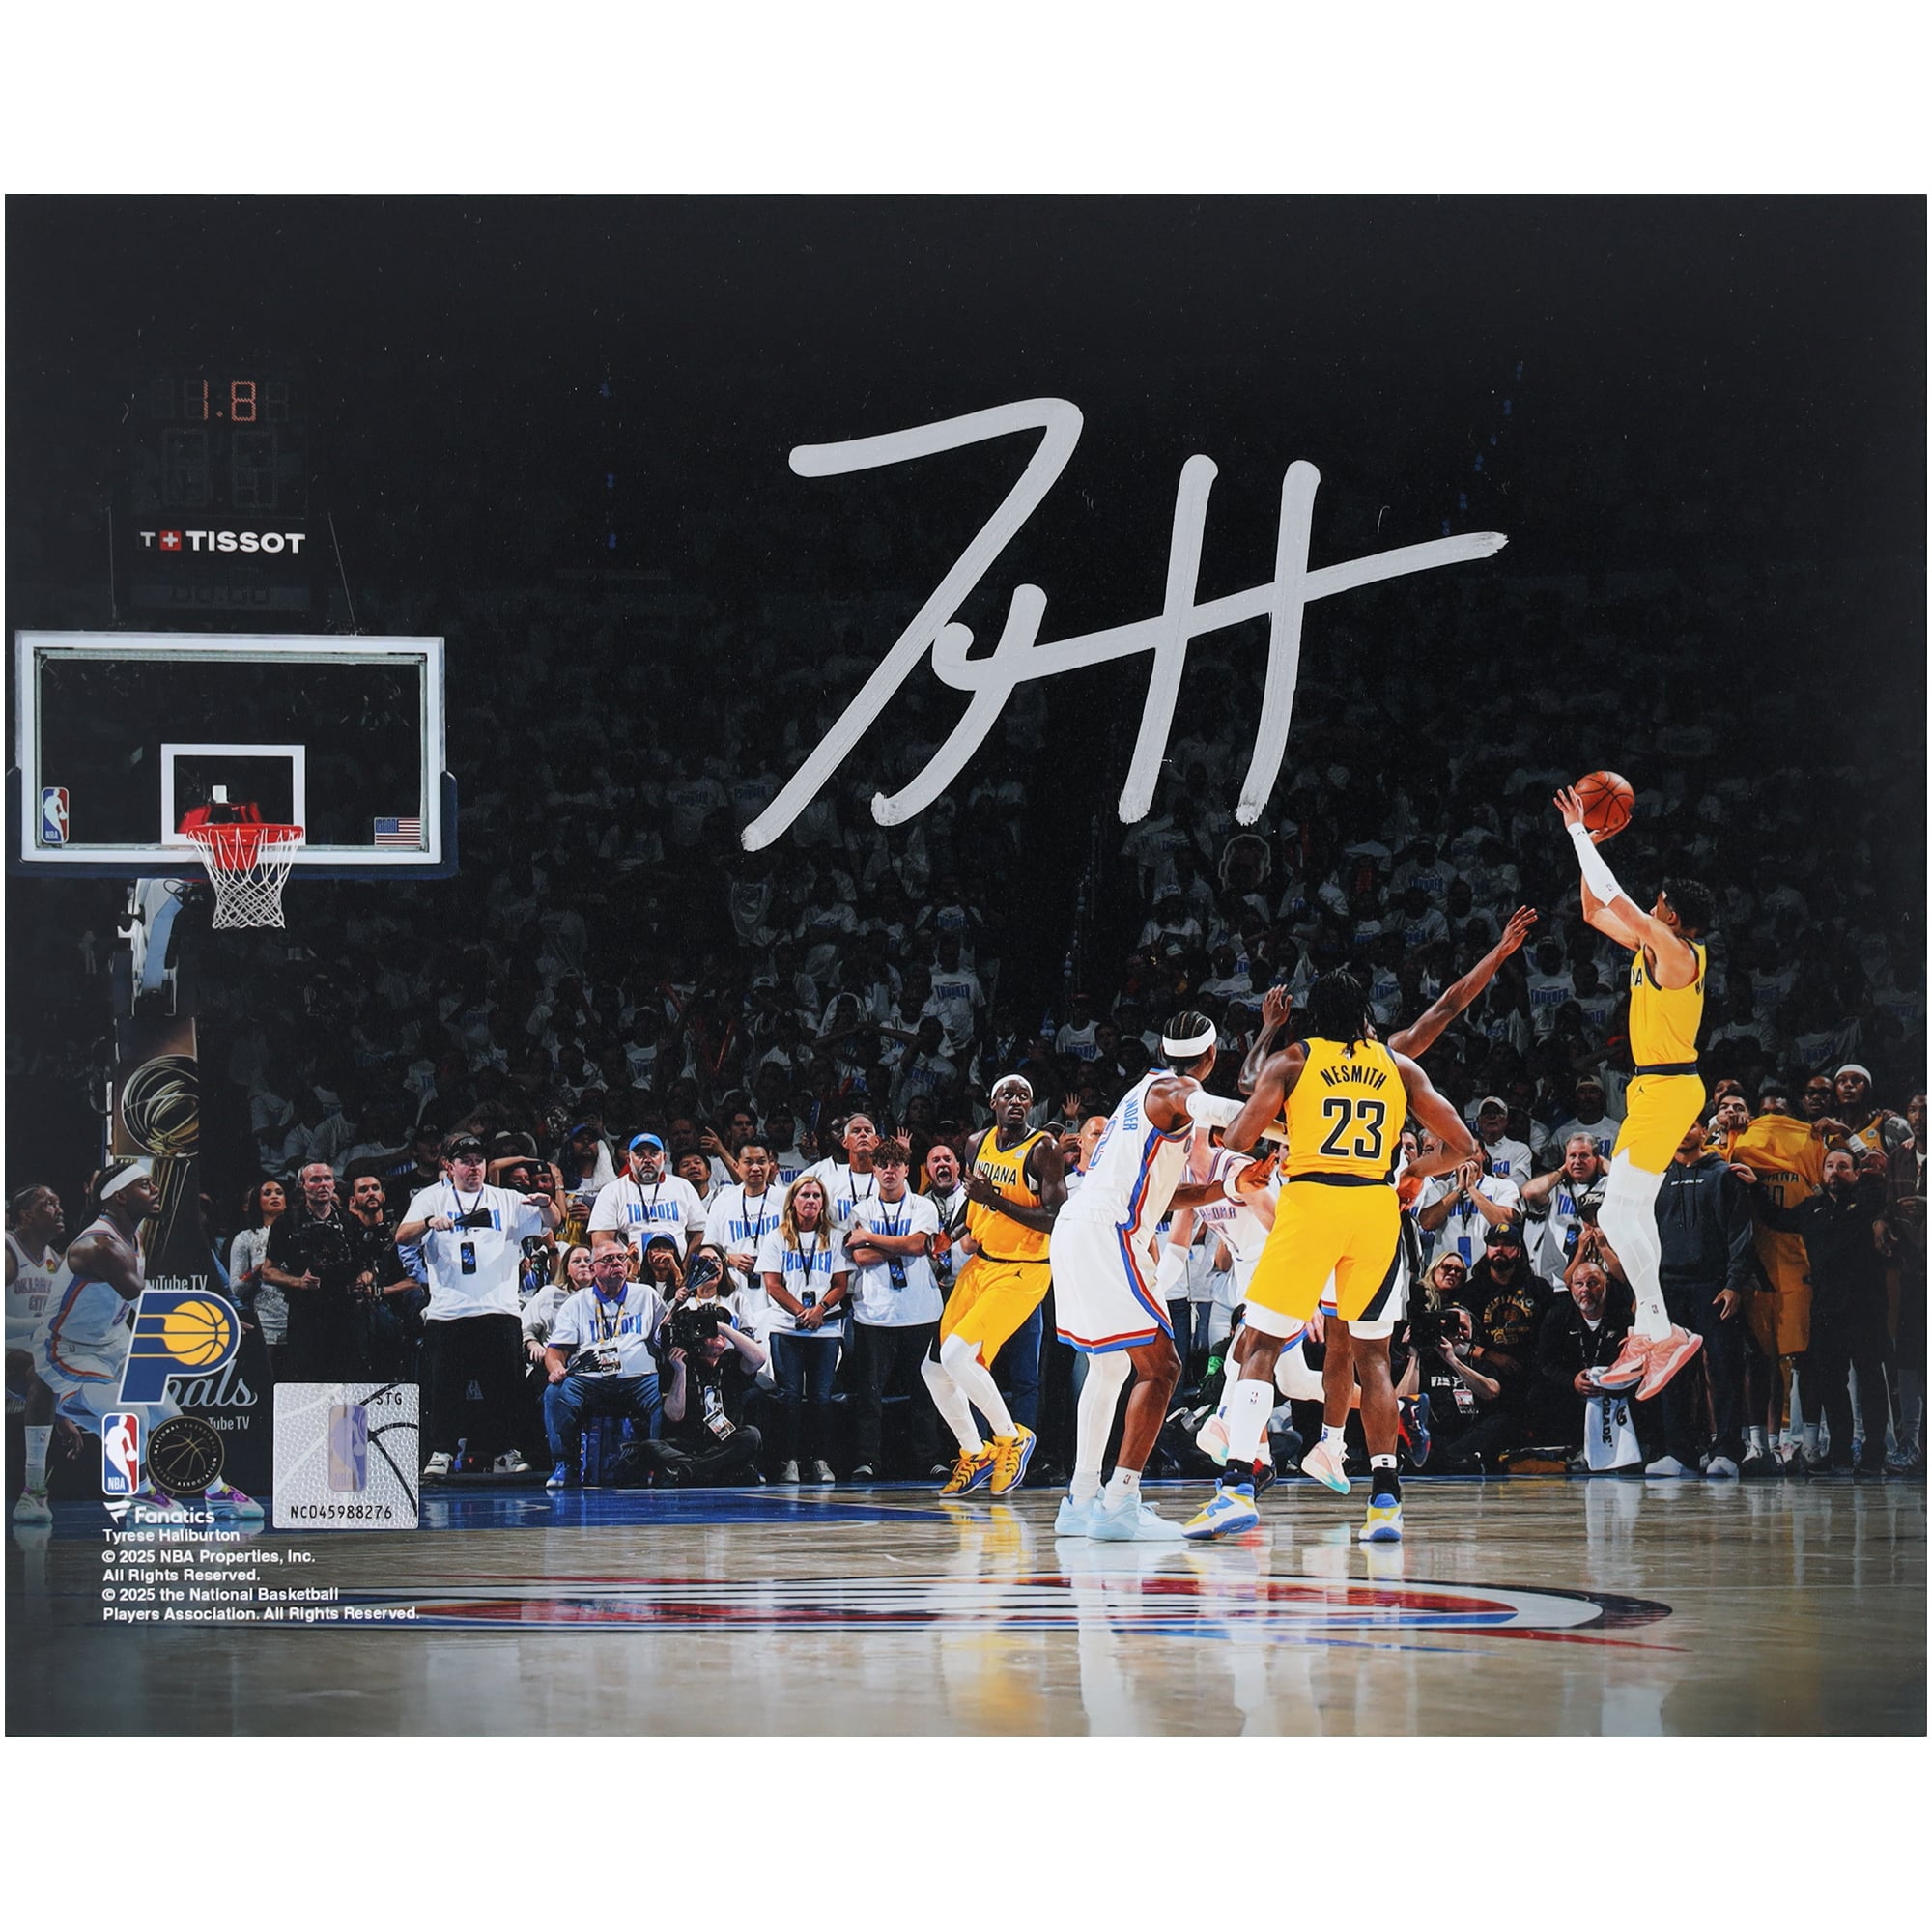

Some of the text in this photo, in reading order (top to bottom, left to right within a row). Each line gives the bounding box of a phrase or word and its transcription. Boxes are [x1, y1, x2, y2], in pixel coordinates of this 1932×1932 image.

[203, 379, 257, 422] 1.8
[185, 530, 306, 554] TISSOT
[1320, 1065, 1387, 1091] NESMITH
[1319, 1097, 1386, 1159] 23
[626, 1201, 679, 1224] THUNDER
[376, 1393, 403, 1406] STG
[236, 1416, 251, 1431] TV
